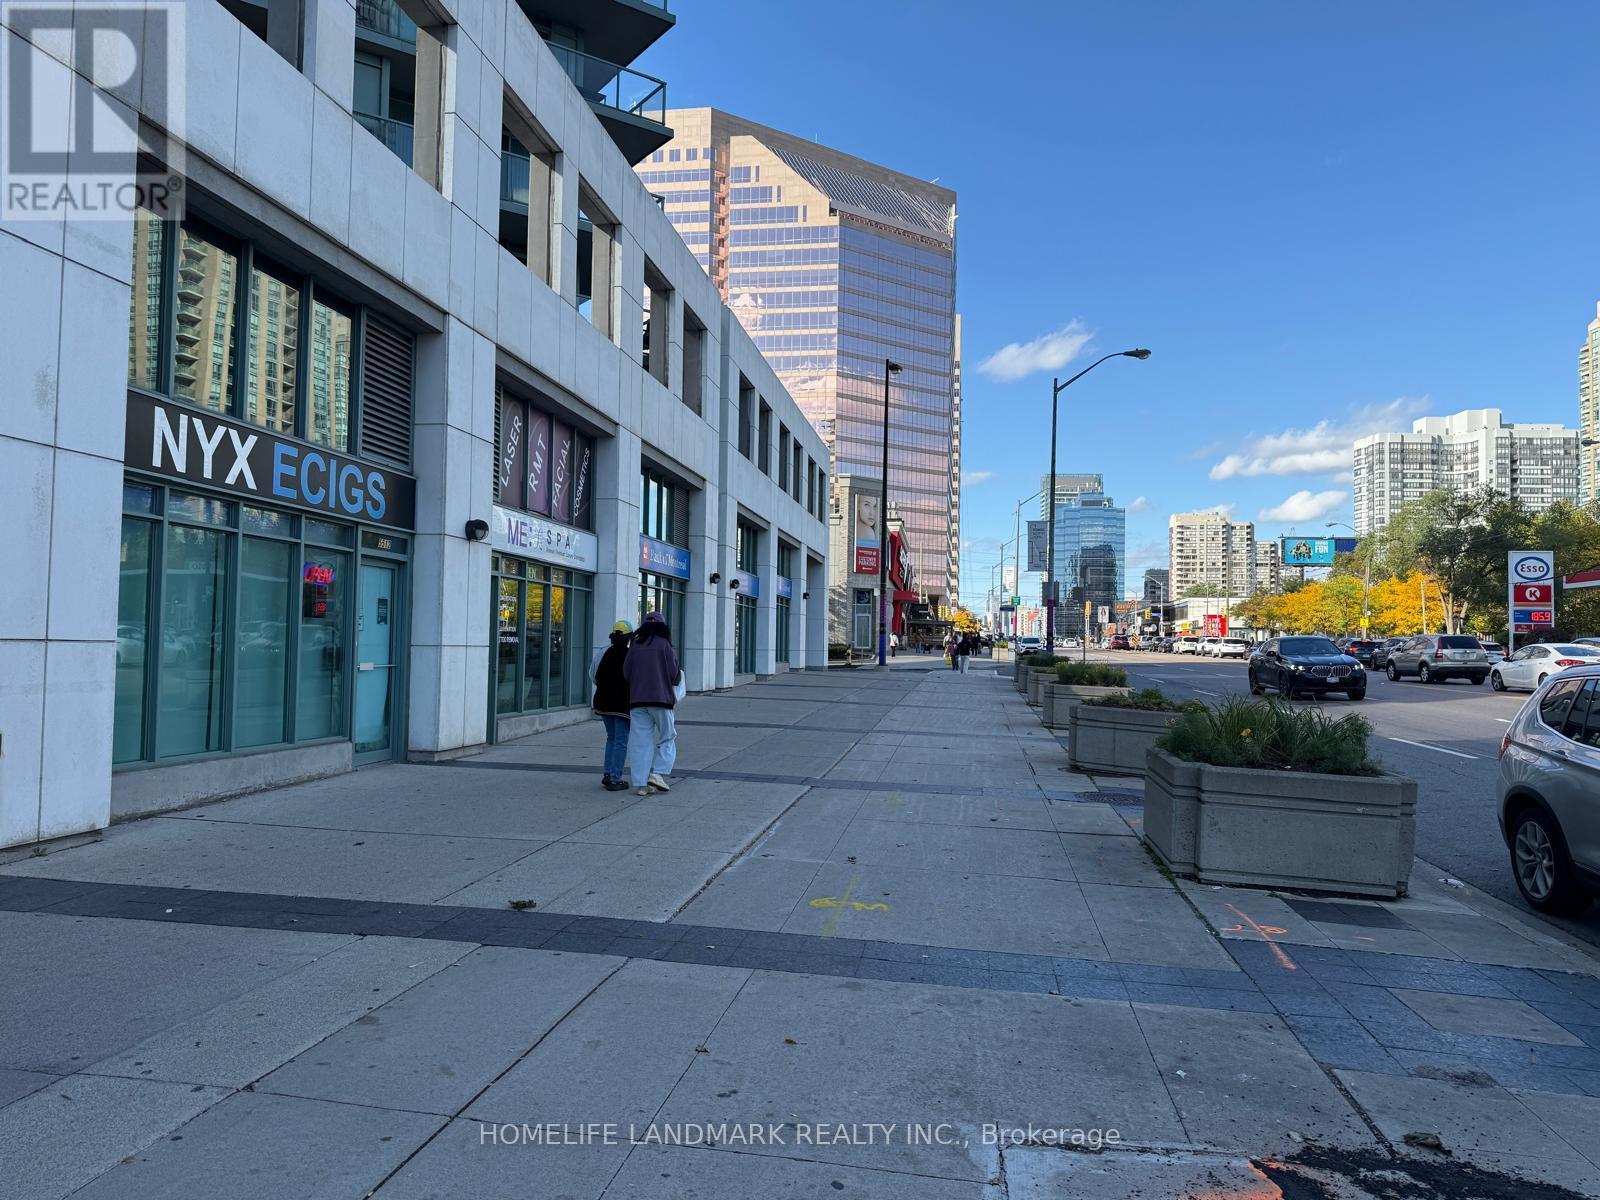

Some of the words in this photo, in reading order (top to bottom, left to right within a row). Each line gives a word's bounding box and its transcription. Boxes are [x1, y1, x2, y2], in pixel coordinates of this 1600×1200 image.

[152, 405, 258, 490] NYX
[272, 441, 386, 520] ECIGS
[501, 415, 522, 487] LASER
[528, 433, 546, 493] RMT
[552, 439, 571, 507] FACIAL
[574, 447, 591, 517] COSMETICS
[546, 529, 571, 550] SPA
[304, 566, 334, 584] OPEN
[1529, 590, 1539, 599] K
